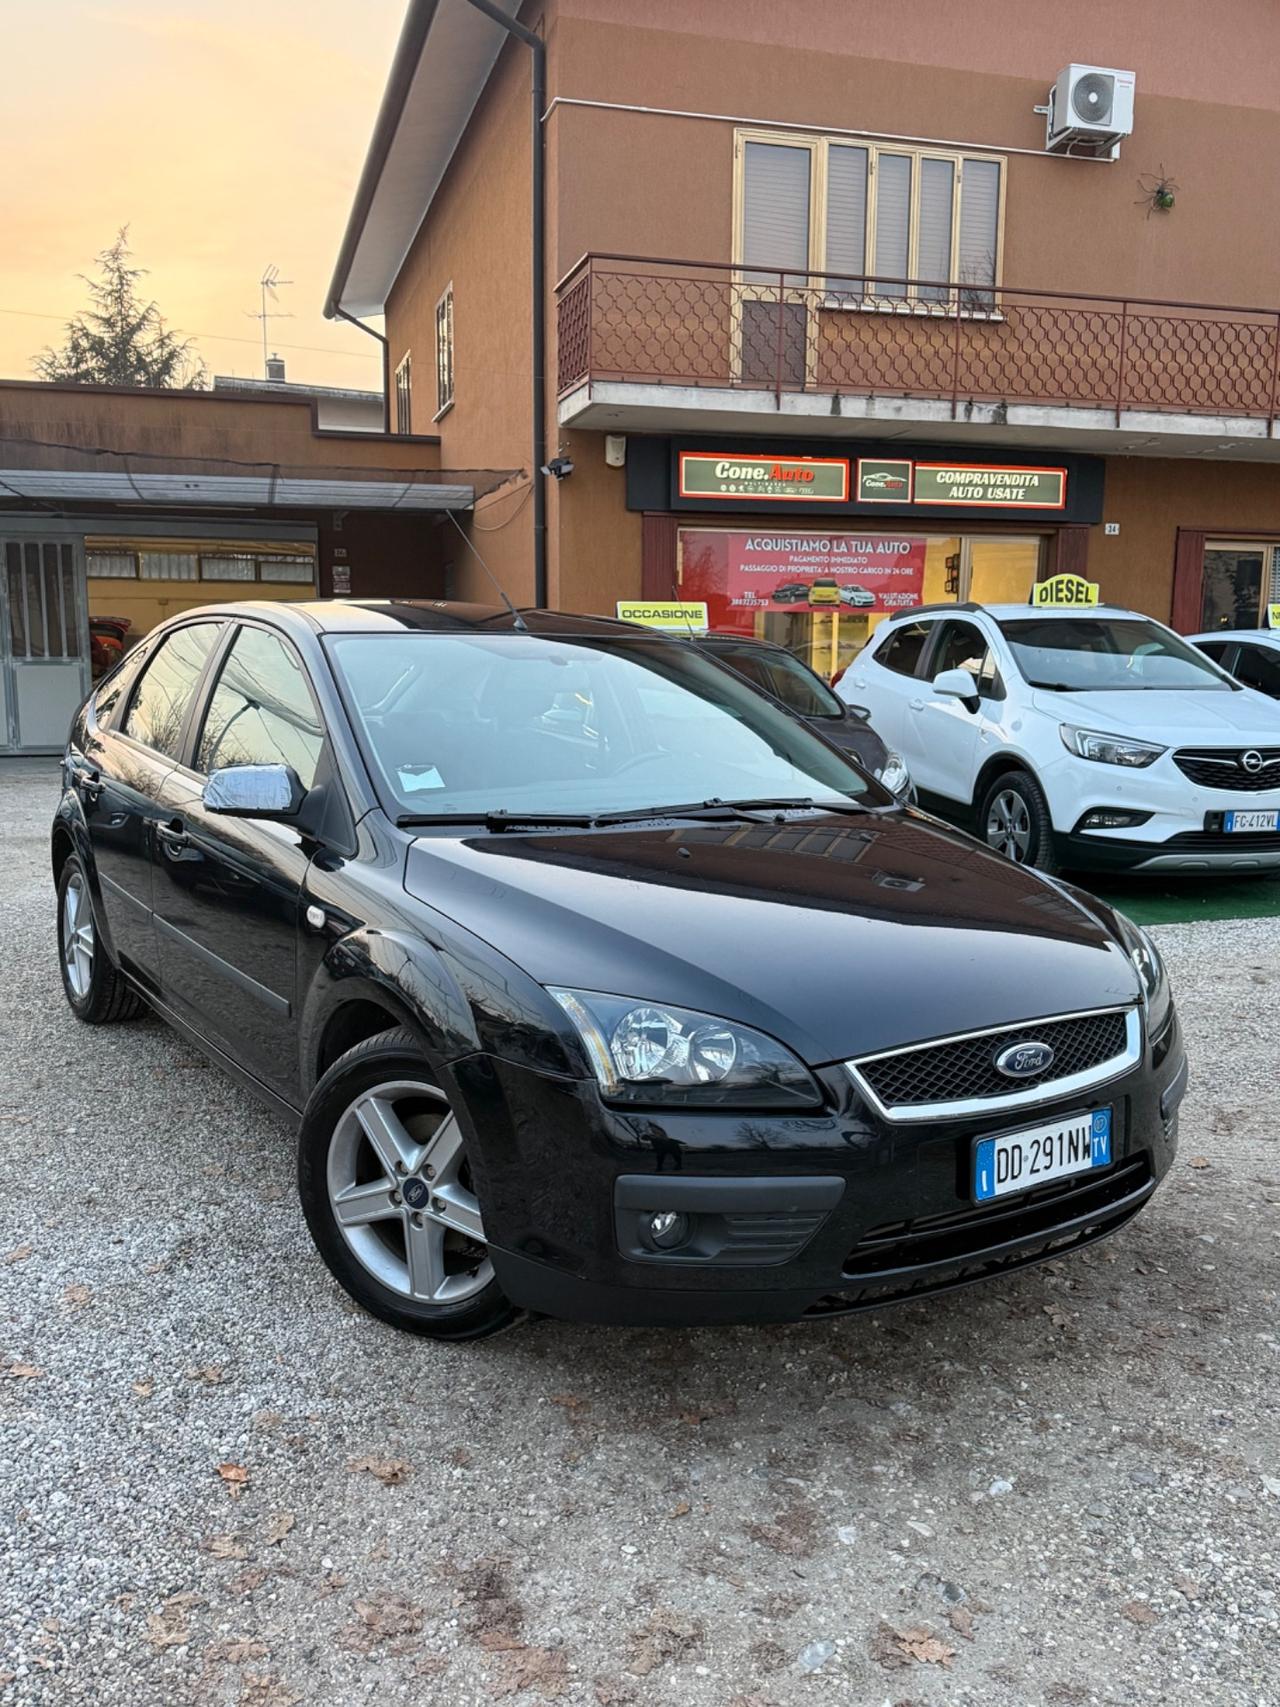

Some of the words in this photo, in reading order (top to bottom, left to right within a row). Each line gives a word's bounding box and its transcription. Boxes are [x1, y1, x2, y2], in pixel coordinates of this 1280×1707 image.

[715, 461, 815, 482] Cone.Auto
[936, 471, 1039, 487] COMPRAVENDITA
[949, 486, 983, 499] AUTO
[987, 487, 1026, 500] USATE
[745, 538, 831, 552] ACQUISTIAMO
[833, 540, 848, 553] LA
[850, 540, 875, 554] TUA
[875, 541, 911, 555] AUTO
[789, 555, 830, 563] PAGAMENTO
[830, 556, 868, 564] IMMEDIATO
[740, 564, 778, 572] PASSAGGIO
[779, 565, 786, 573] DI
[824, 566, 829, 574] A
[859, 567, 884, 575] CARICO
[900, 568, 914, 576] ORE
[878, 592, 919, 600] VALUTAZIONE
[1039, 579, 1092, 603] DIESEL
[883, 599, 914, 607] GRATUITA
[622, 609, 703, 619] OCCASIONE
[1014, 1049, 1044, 1070] Ford
[1093, 1135, 1107, 1157] TV
